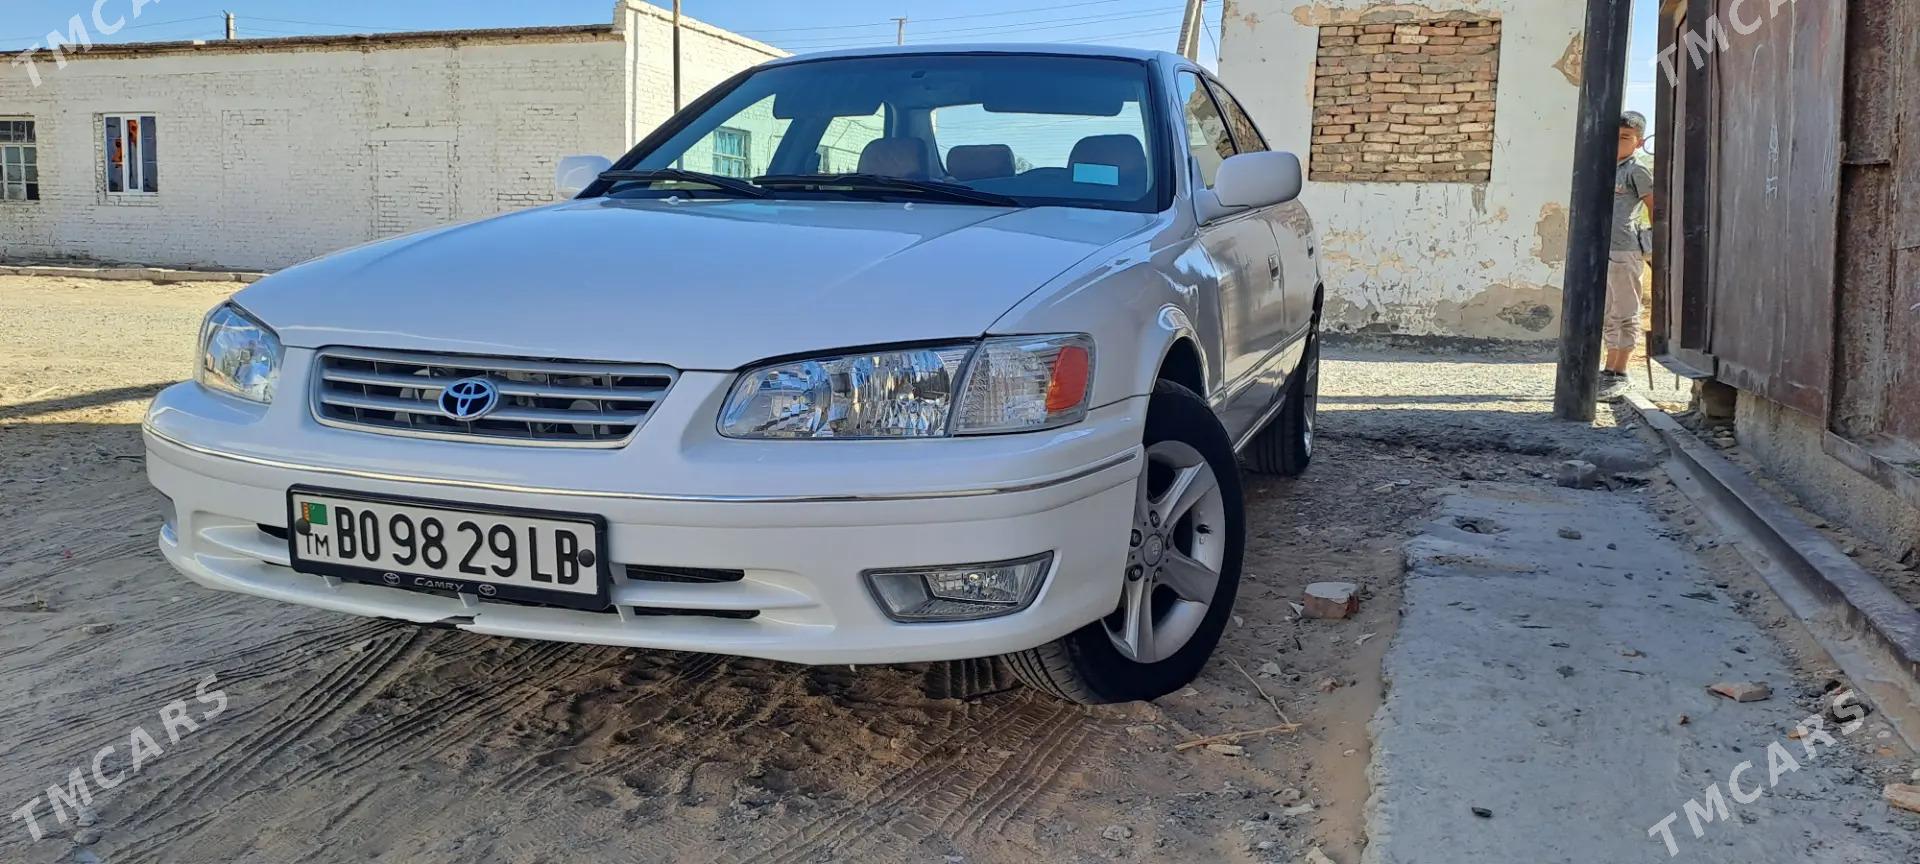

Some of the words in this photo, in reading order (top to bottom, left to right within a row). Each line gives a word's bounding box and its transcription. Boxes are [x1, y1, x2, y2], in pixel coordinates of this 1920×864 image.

[304, 531, 330, 556] TM
[389, 513, 448, 569] 98
[457, 521, 517, 577] 29
[528, 526, 580, 584] LB
[413, 577, 464, 591] CAMRY
